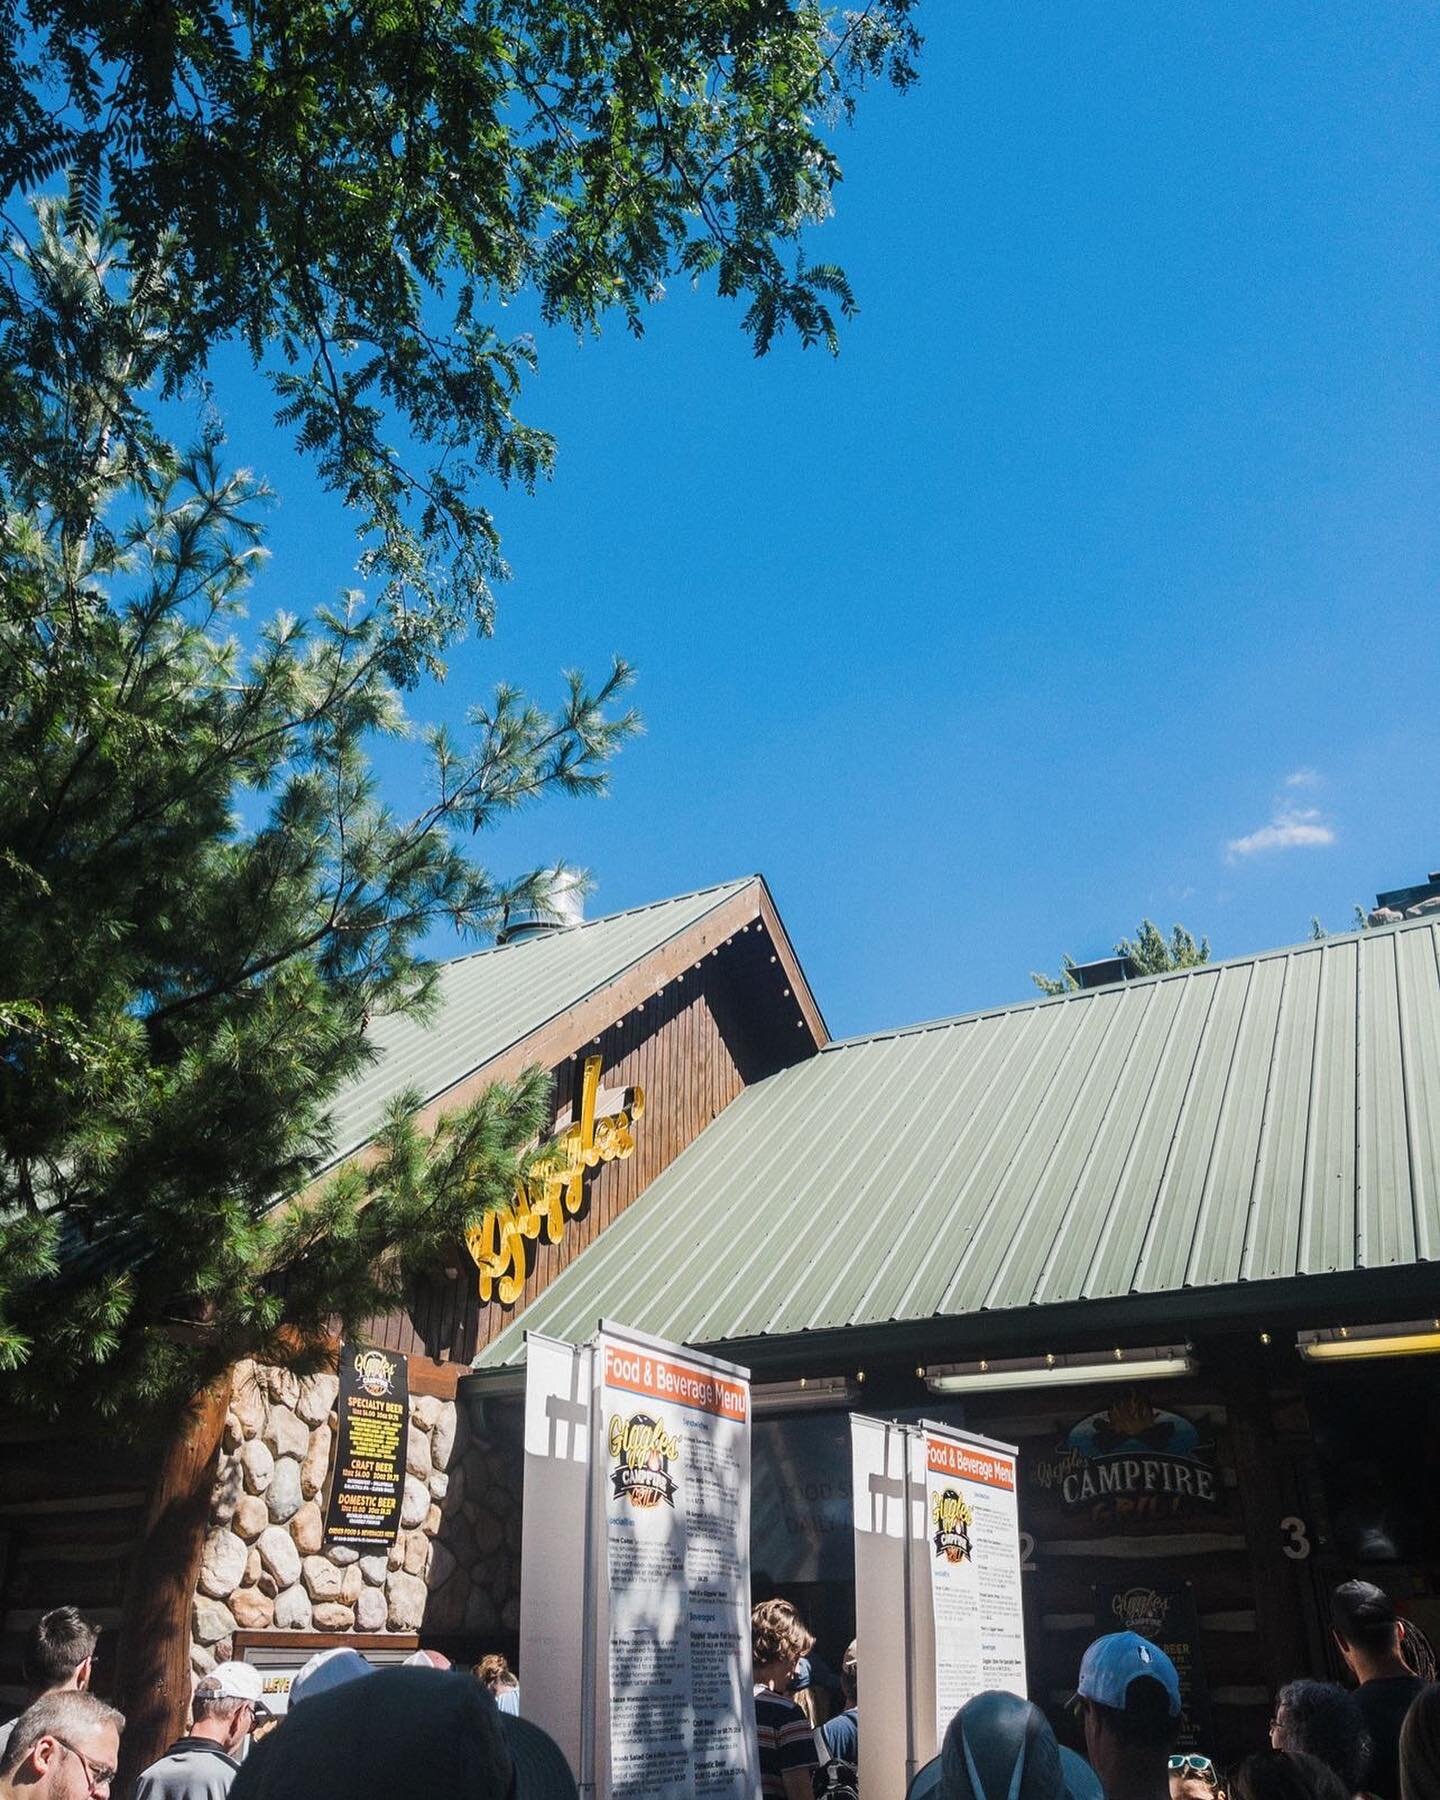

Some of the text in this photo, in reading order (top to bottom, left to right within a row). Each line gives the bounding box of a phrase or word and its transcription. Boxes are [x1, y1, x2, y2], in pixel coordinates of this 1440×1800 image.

[605, 1352, 746, 1412] Food & Beverage Menu
[347, 1396, 403, 1414] SPECIALTY BEER
[351, 1459, 394, 1473] CRAFT BEER
[949, 1450, 955, 1467] &
[957, 1450, 993, 1480] Beverage
[1062, 1460, 1216, 1503] CAMPFIRE
[338, 1493, 396, 1508] DOMESTIC BEER
[1019, 1531, 1037, 1571] 2
[1281, 1517, 1312, 1560] 3
[263, 1678, 290, 1694] LLEYE
